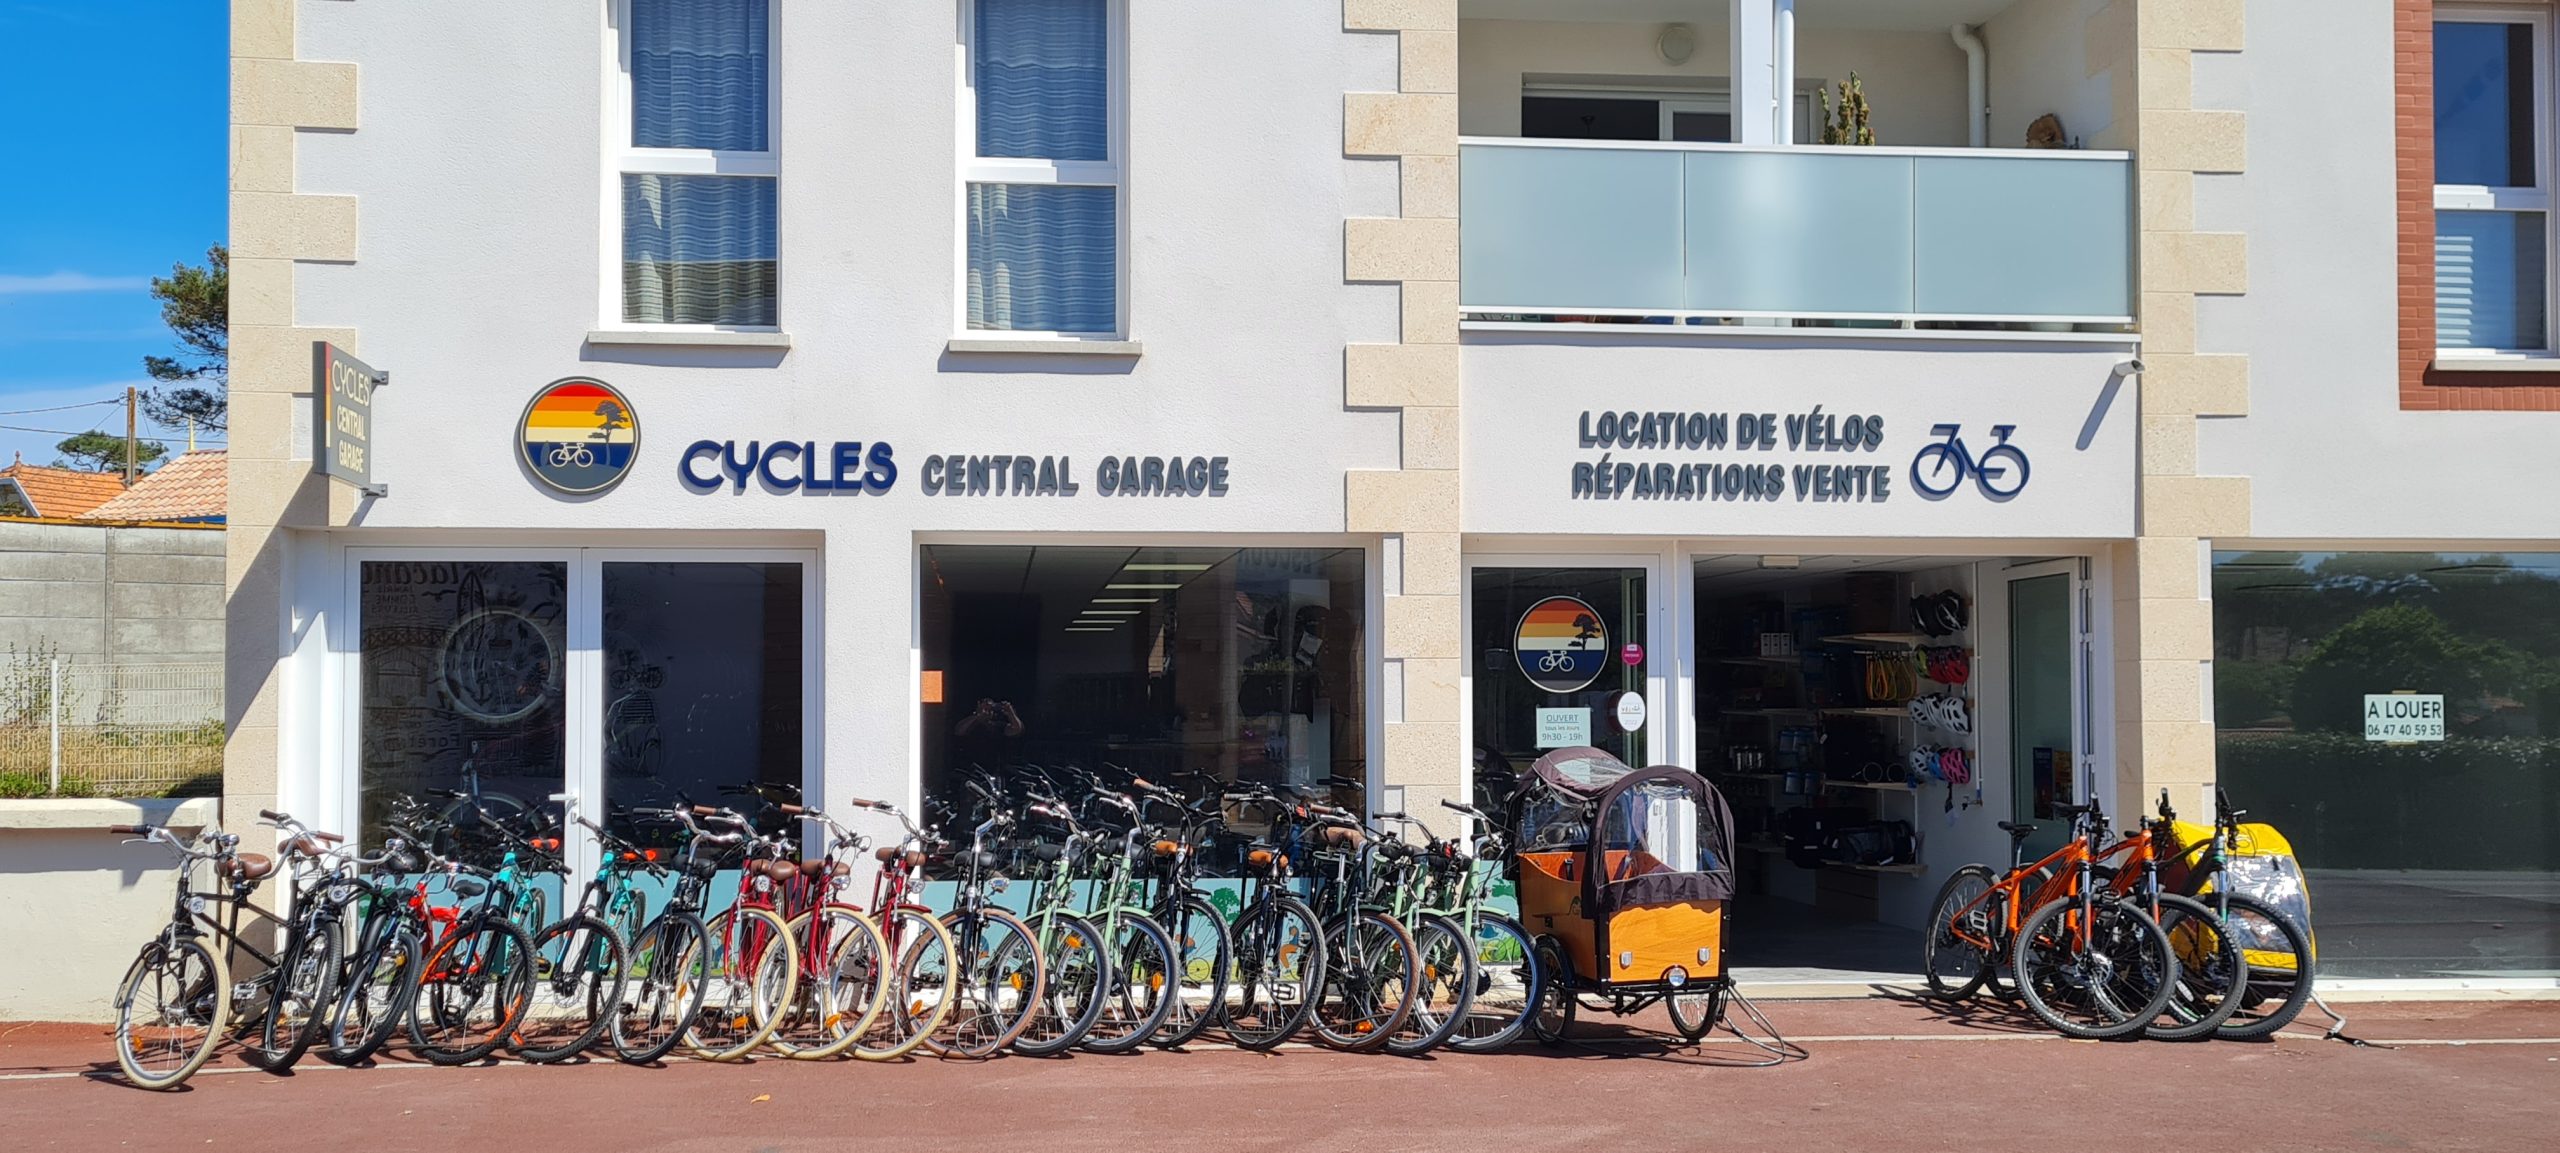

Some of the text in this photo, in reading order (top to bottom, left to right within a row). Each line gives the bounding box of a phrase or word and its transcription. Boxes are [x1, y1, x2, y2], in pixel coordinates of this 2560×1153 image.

[332, 360, 370, 406] CYCLES
[337, 404, 365, 440] CENTRAL
[1579, 404, 1884, 452] LOCATION DE VÉLOS
[339, 440, 363, 473] GARAGE
[681, 439, 1230, 497] CYCLES CENTRAL GARAGE
[1572, 453, 1890, 503] RÉPARATIONS VENTE
[1546, 714, 1579, 722] OUVERT
[2368, 701, 2441, 718] A LOUER
[1542, 732, 1562, 741] 9h30
[1569, 732, 1583, 741] 19h
[2367, 724, 2442, 735] 06 47 40 59 53
